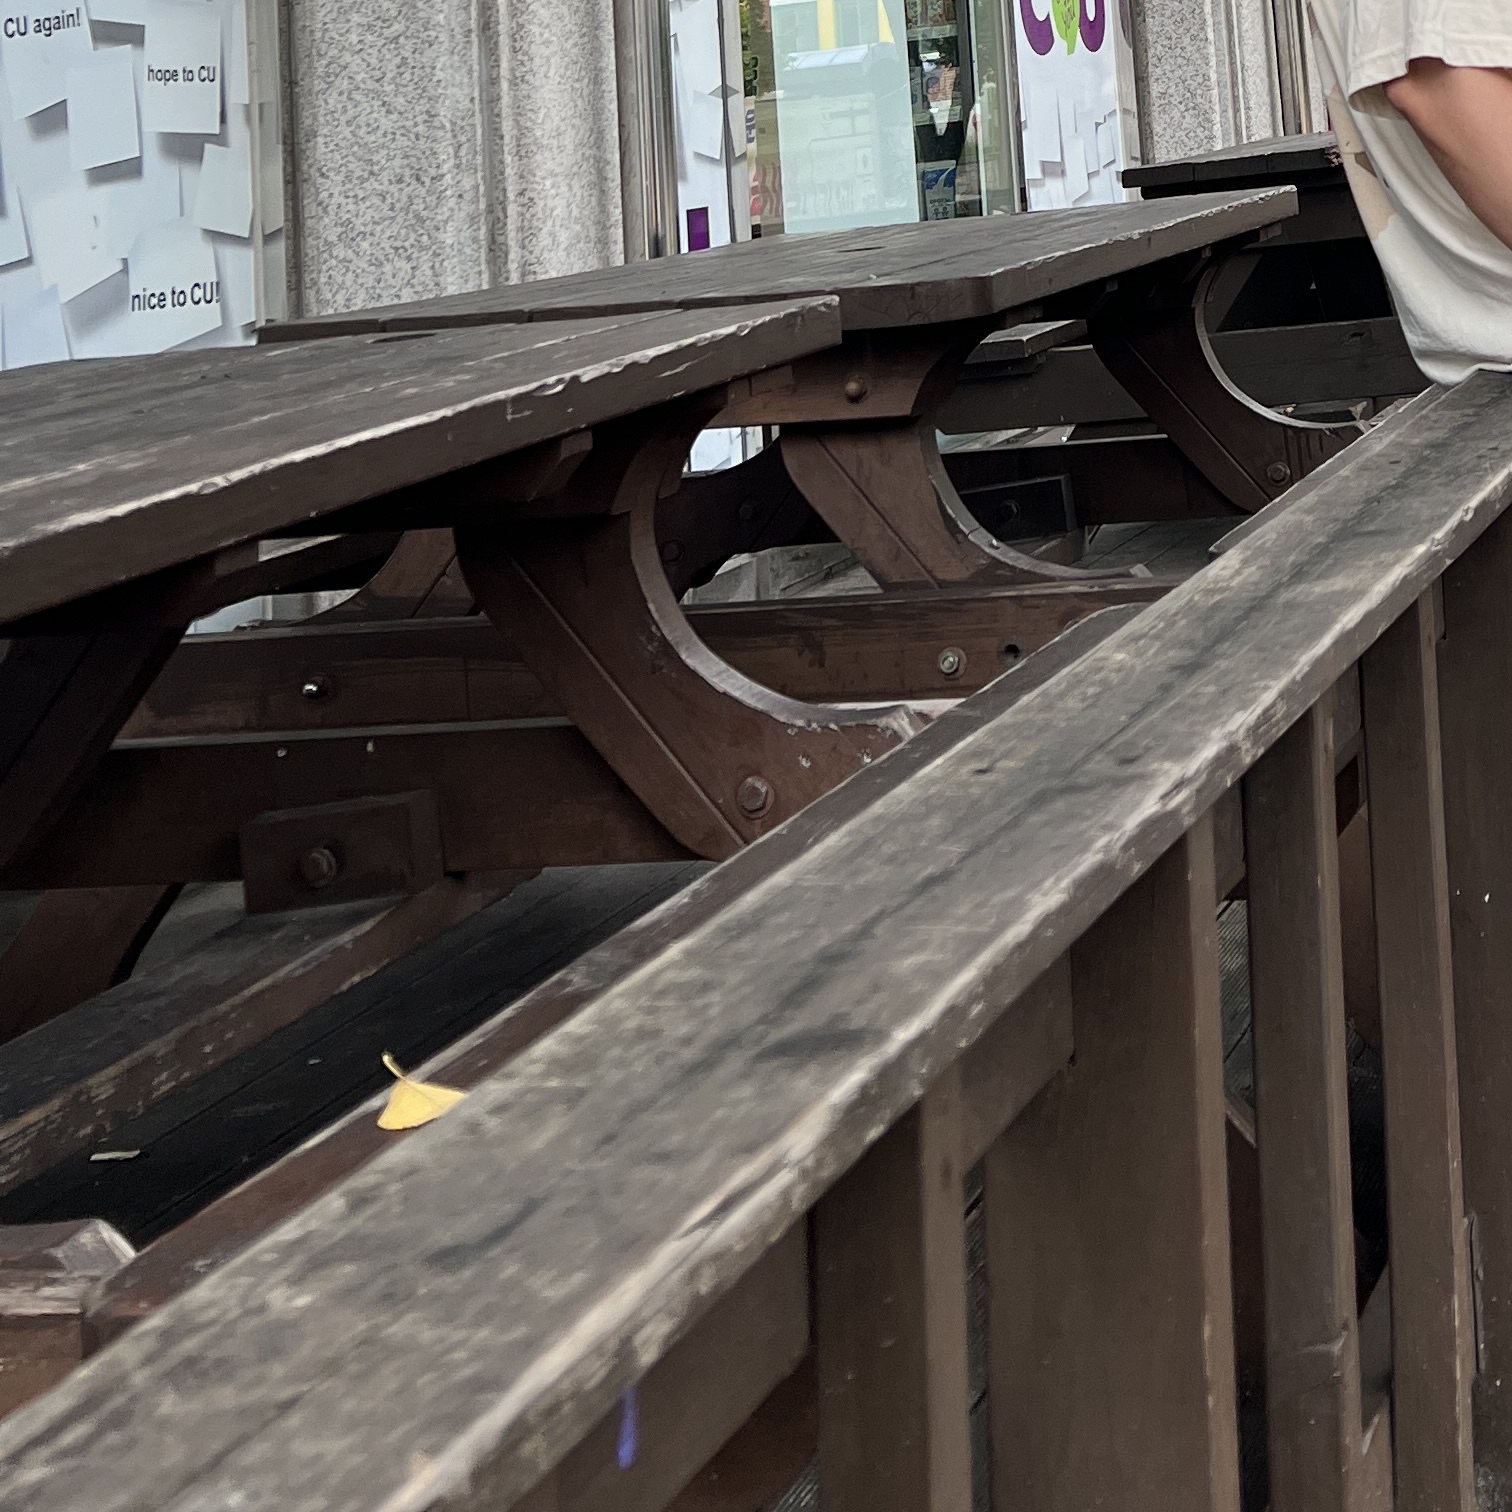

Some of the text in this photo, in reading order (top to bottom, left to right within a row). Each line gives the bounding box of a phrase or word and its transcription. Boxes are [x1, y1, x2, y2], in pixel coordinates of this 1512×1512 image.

[3, 6, 81, 39] CU again!
[147, 64, 216, 86] hope to CU
[131, 281, 221, 312] nice to CU!
